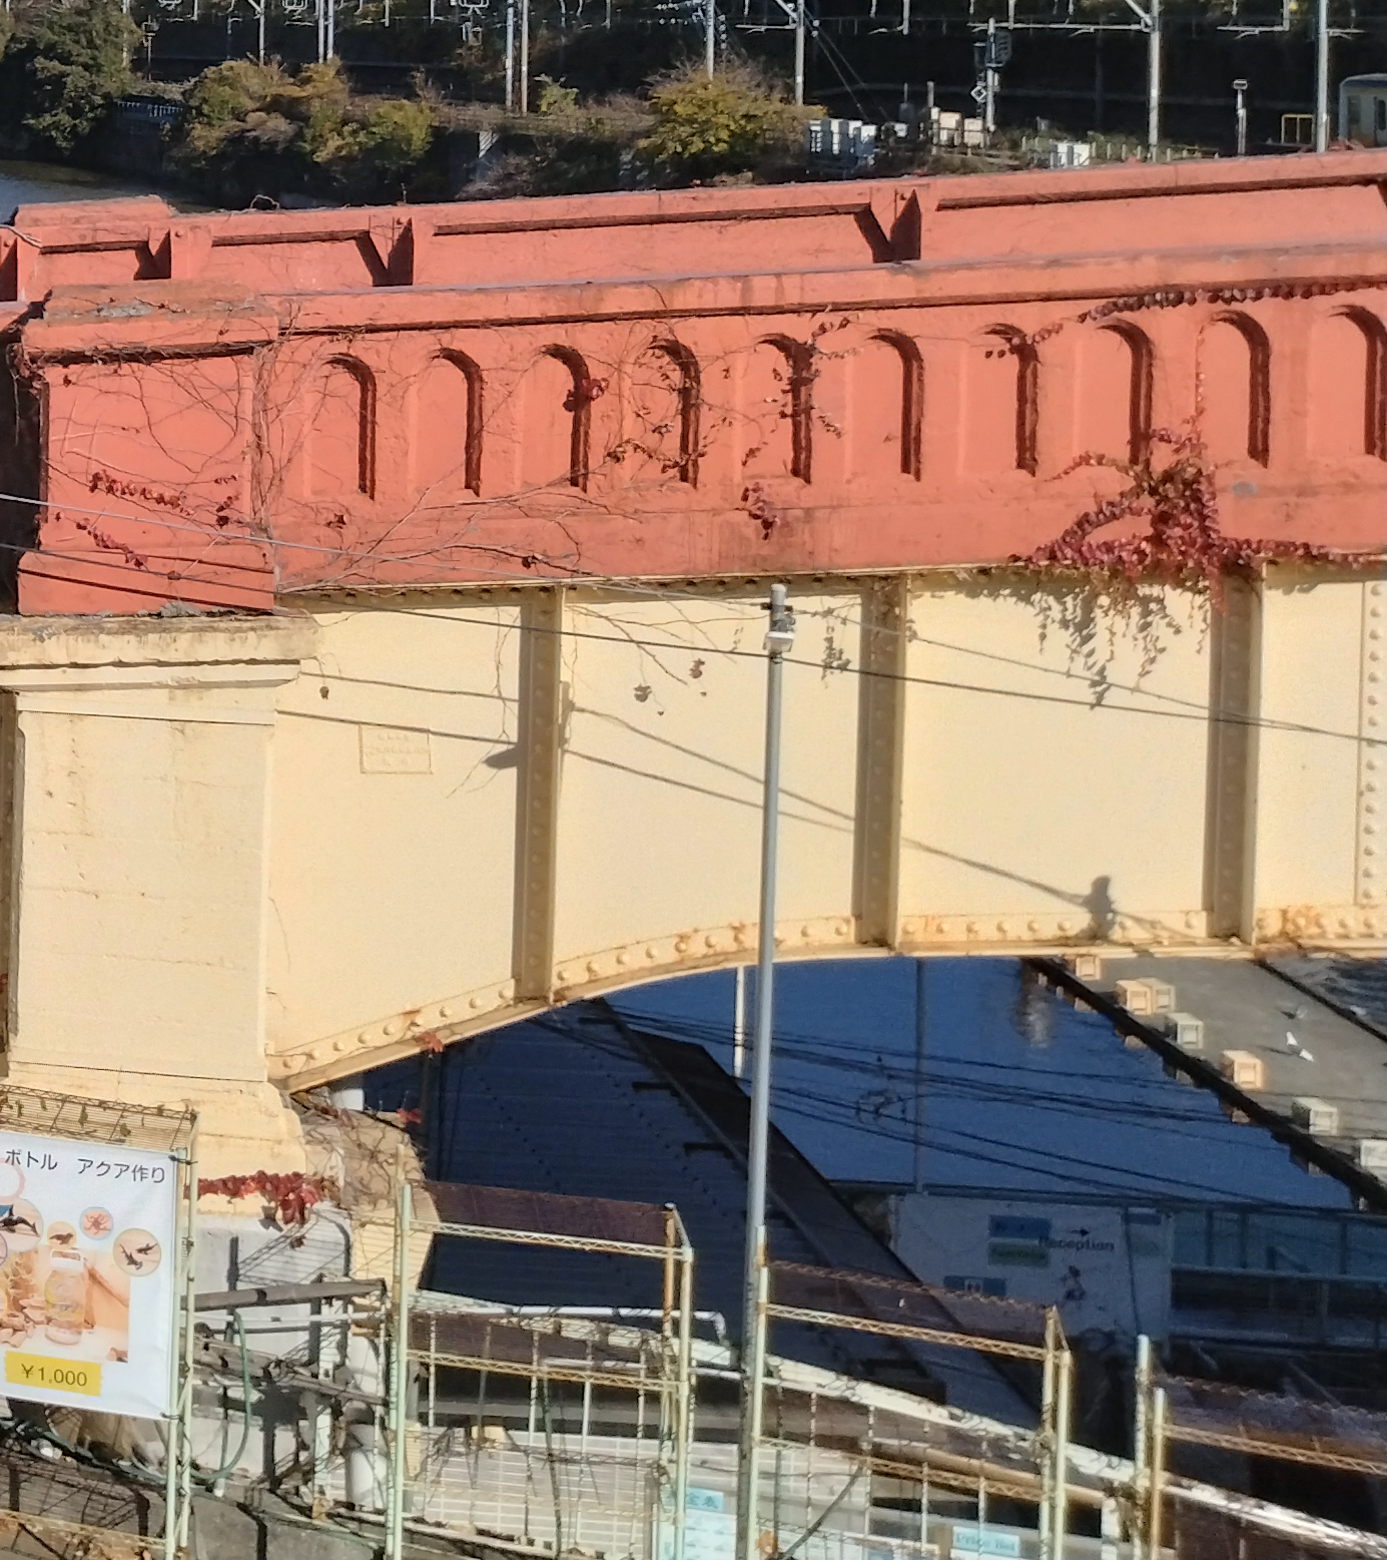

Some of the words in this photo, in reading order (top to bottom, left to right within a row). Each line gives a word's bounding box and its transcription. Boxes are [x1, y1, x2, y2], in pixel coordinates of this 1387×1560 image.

[5, 1149, 58, 1171] ボトル
[77, 1158, 166, 1183] アクア作り
